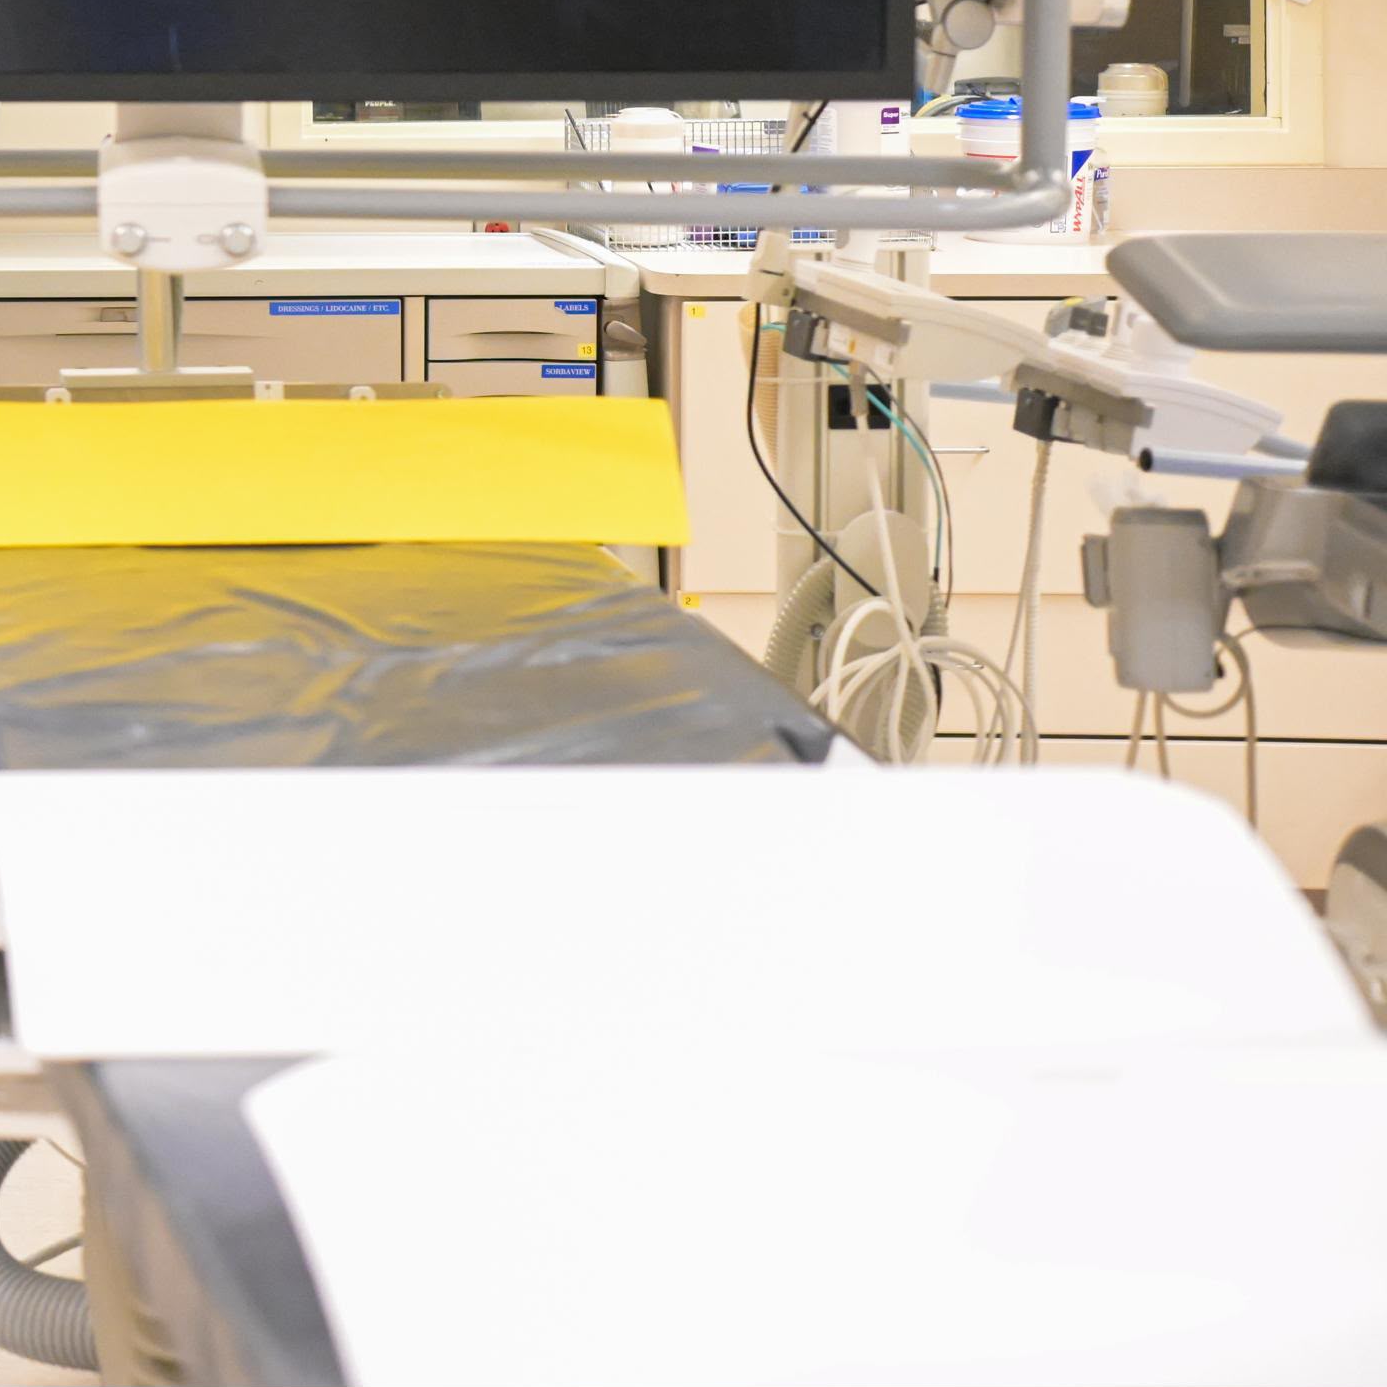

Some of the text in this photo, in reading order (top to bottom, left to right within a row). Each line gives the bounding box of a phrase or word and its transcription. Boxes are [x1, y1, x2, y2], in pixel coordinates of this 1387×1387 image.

[278, 305, 319, 313] DRESSINGS
[325, 304, 366, 312] LIDOCAINE
[582, 345, 593, 355] 13
[545, 367, 591, 375] SORBAVIEW
